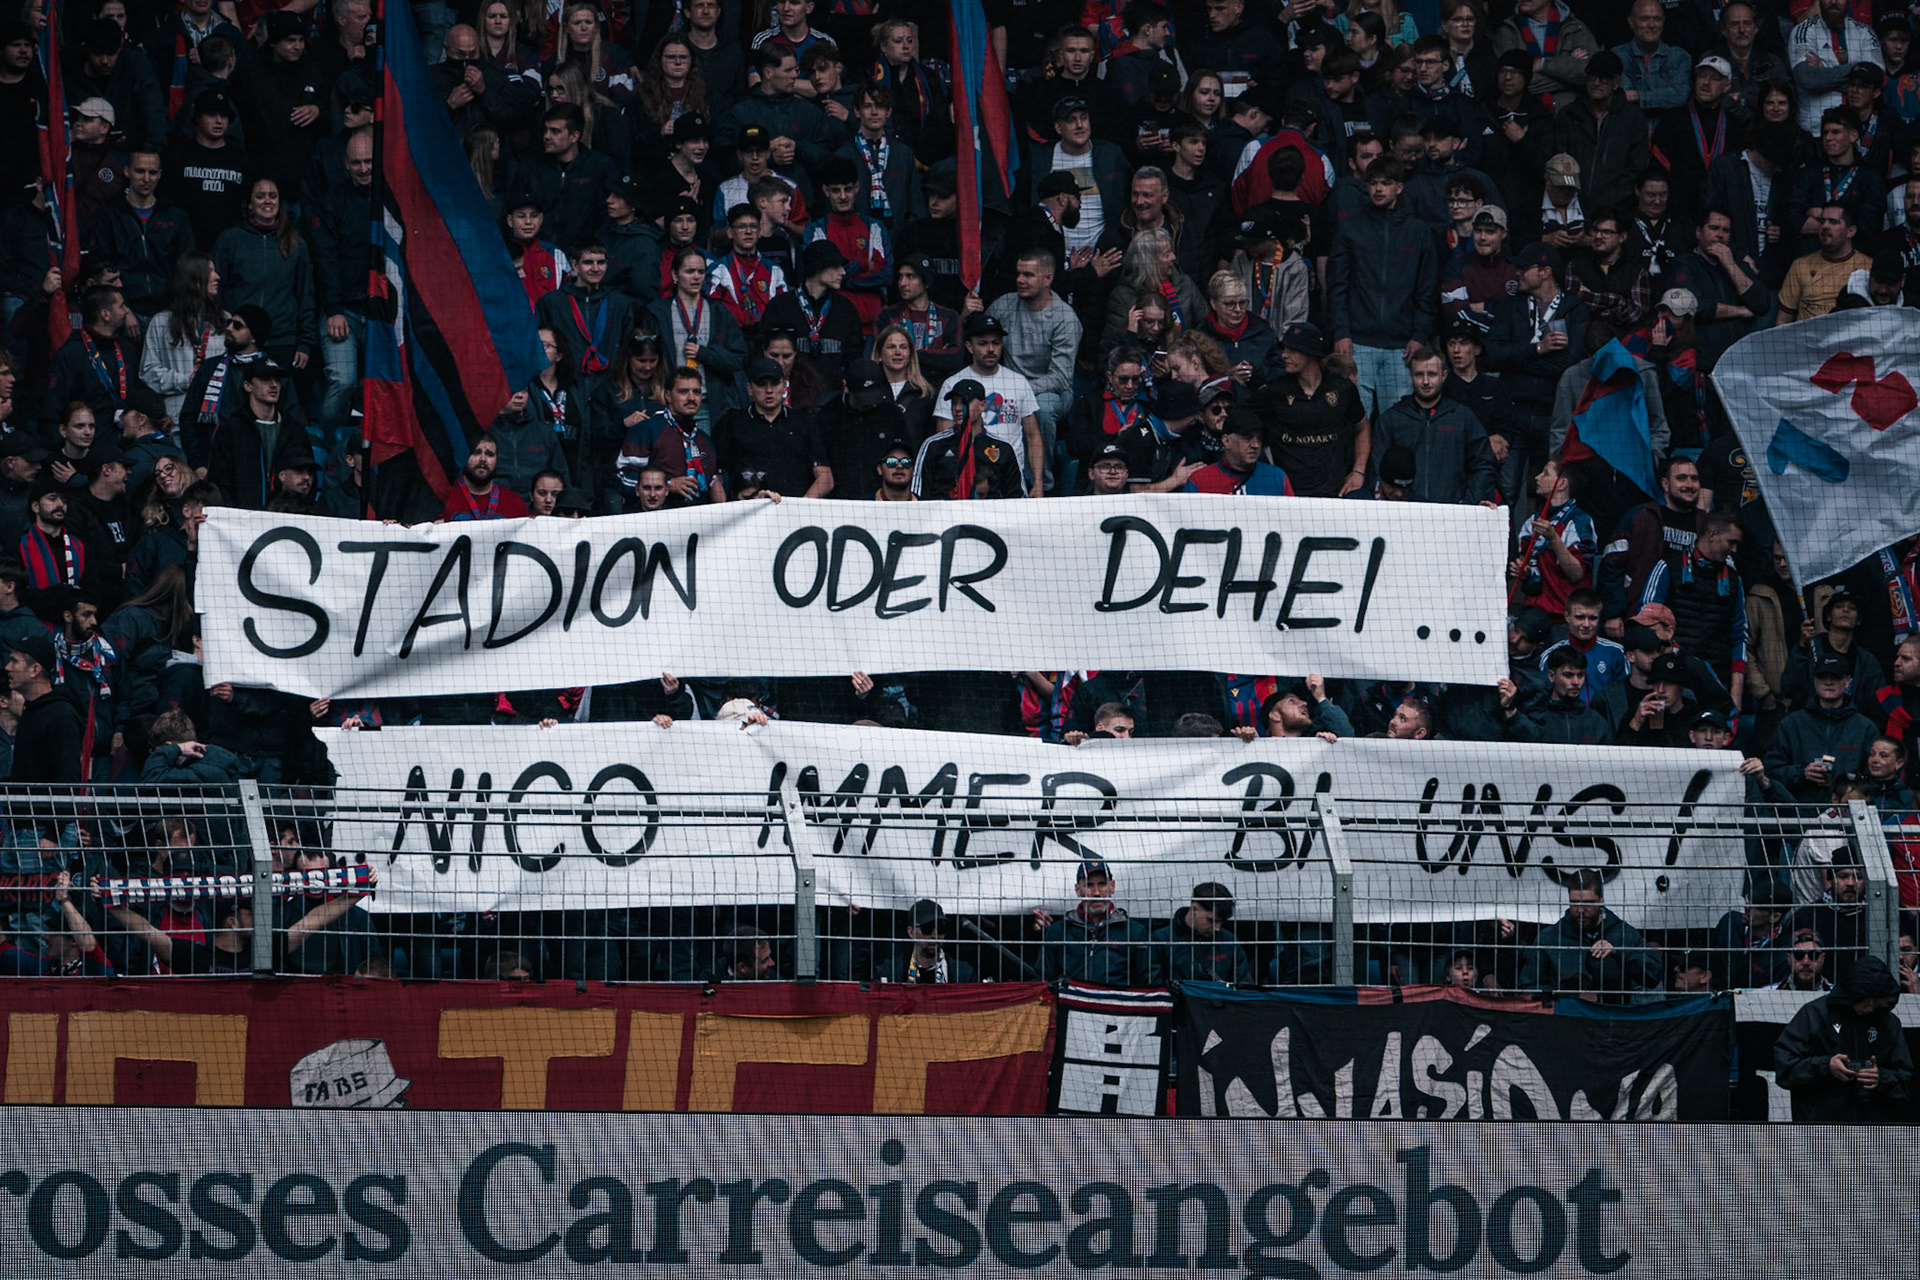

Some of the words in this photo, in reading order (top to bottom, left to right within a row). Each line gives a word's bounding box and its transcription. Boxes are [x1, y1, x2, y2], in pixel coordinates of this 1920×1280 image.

[237, 525, 699, 660] STADION
[773, 524, 1008, 619] ODER
[1094, 515, 1387, 634] DEHEI
[388, 760, 658, 873] NICO
[757, 760, 1119, 870] IMMER
[457, 1138, 1633, 1280] Carreiseangebot
